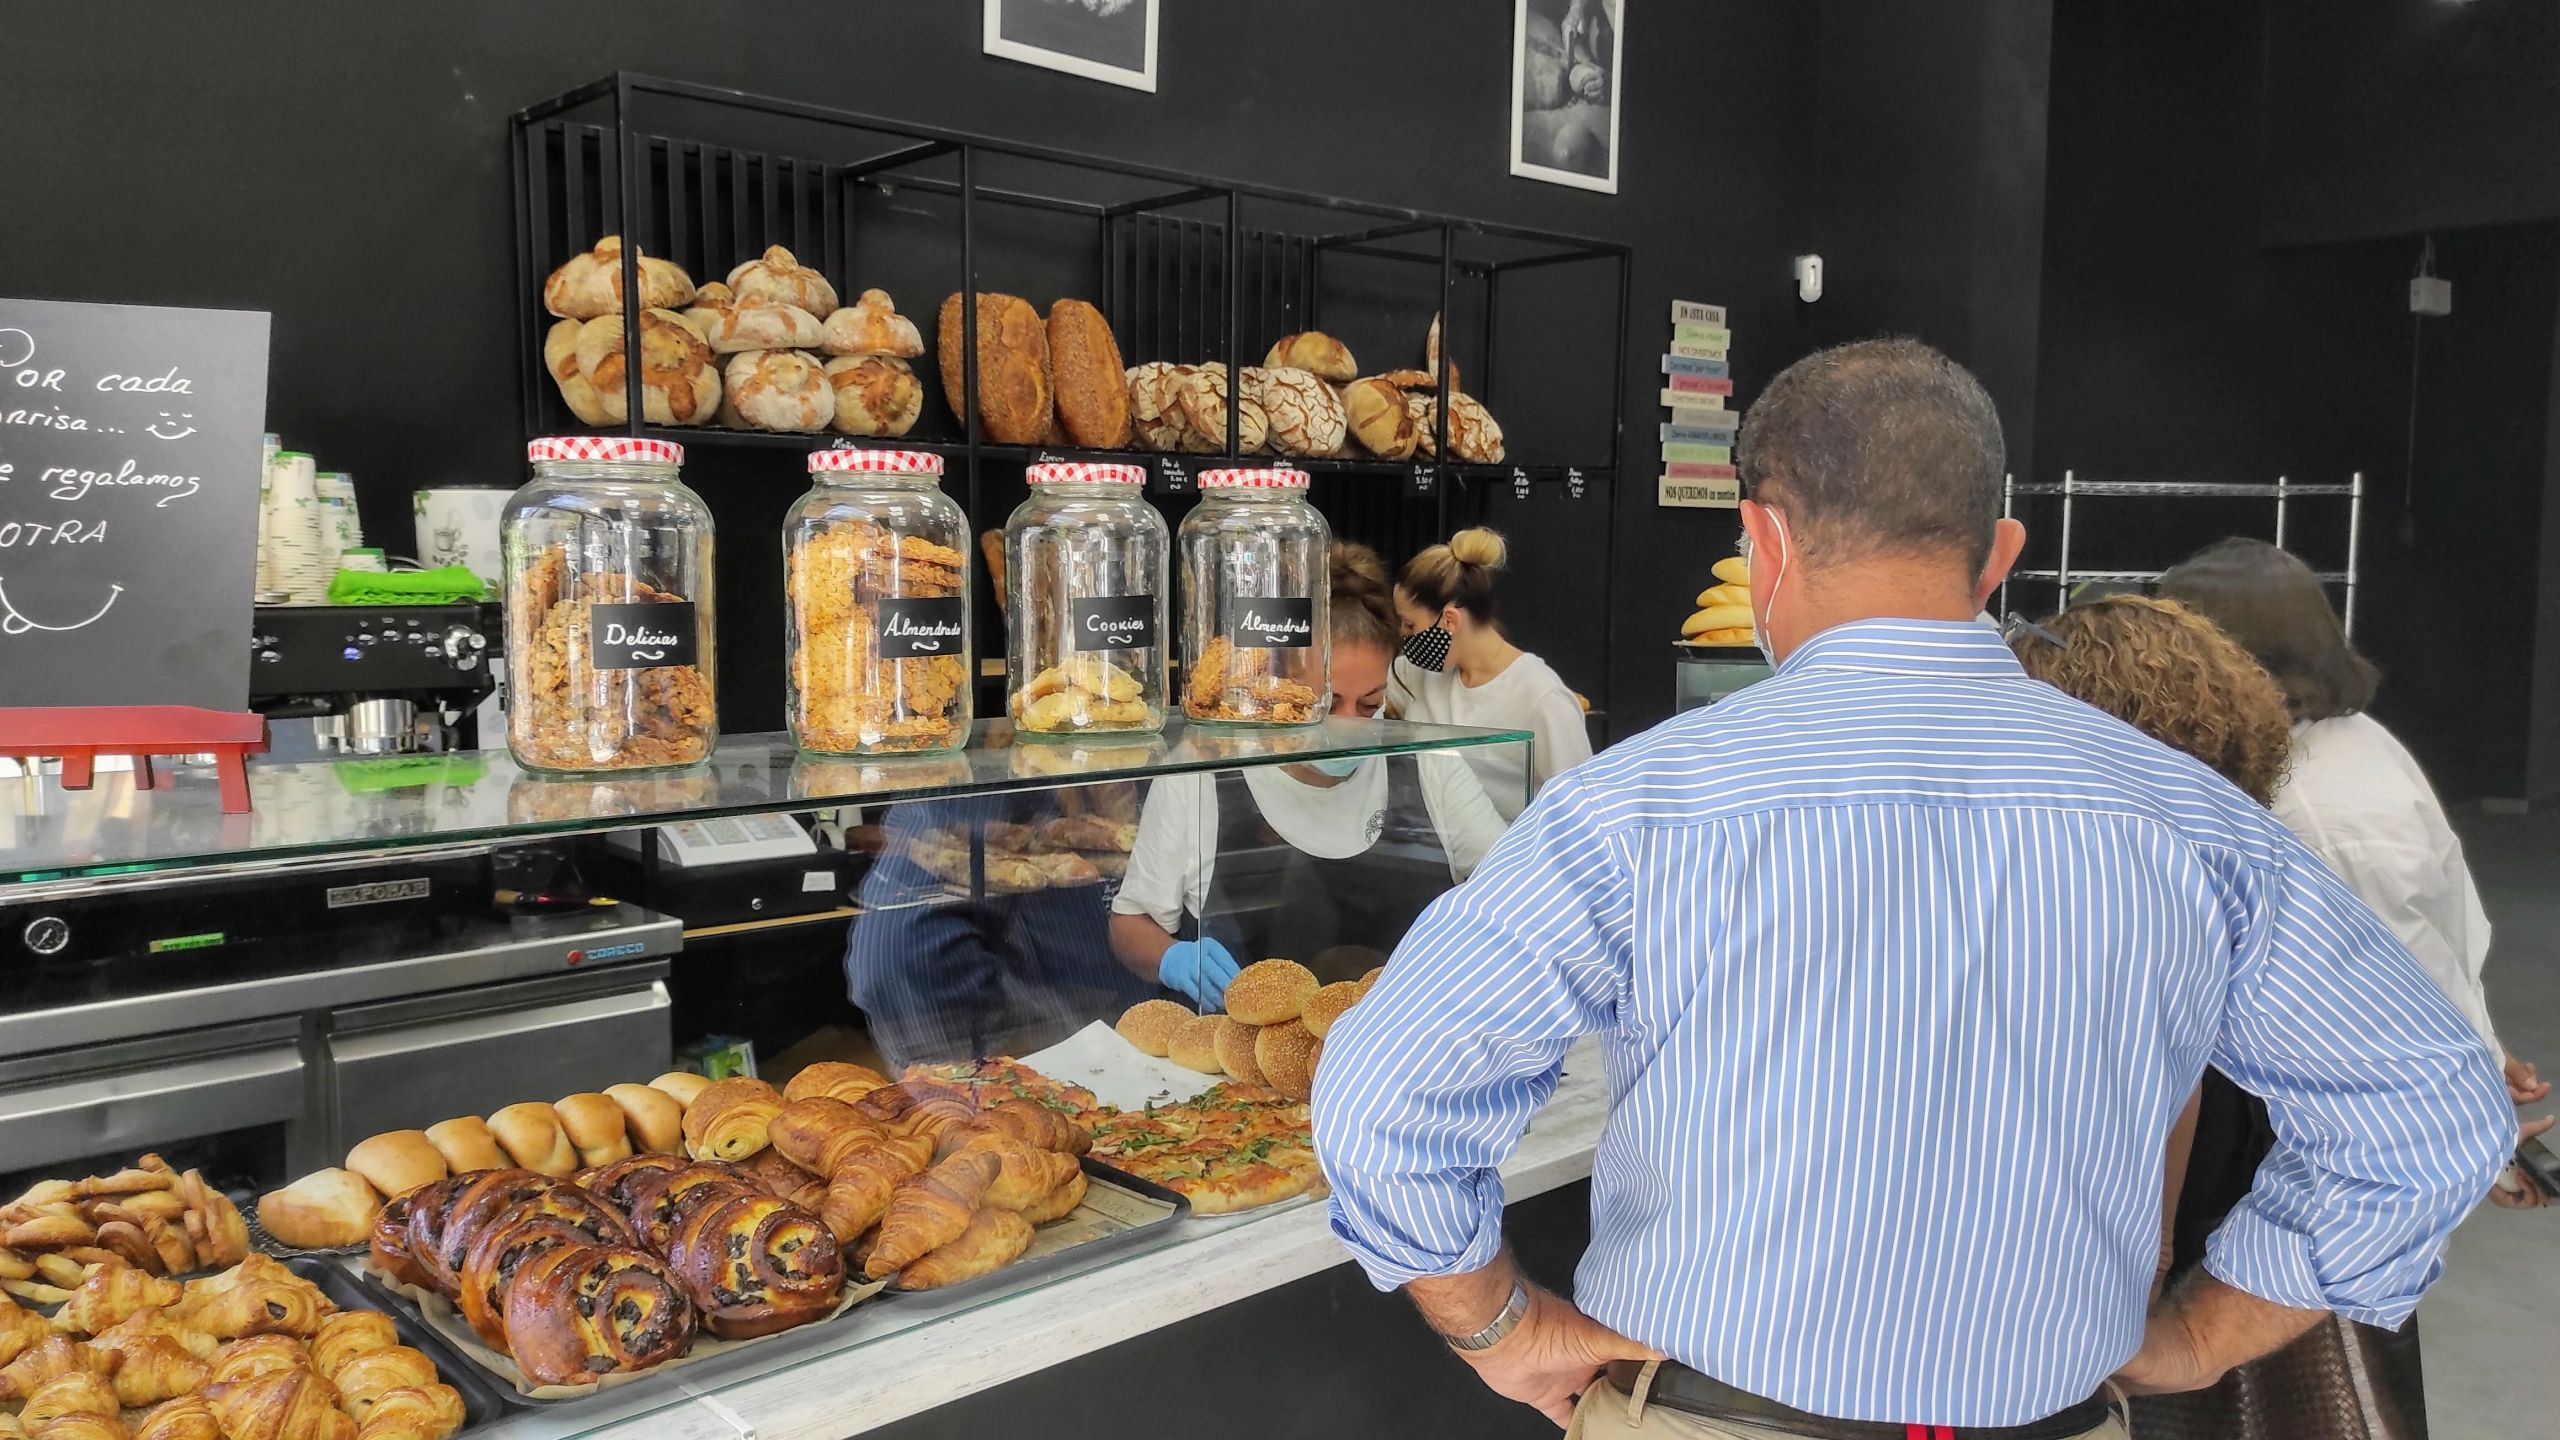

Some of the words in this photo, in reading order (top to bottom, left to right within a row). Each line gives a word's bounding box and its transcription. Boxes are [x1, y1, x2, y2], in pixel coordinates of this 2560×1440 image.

[96, 366, 193, 394] cada
[40, 459, 201, 507] regalamos
[1664, 486, 1677, 499] NOS
[1677, 487, 1708, 502] QUEREMOS
[0, 519, 108, 547] OTRA
[1240, 609, 1310, 633] Almendrado
[603, 623, 678, 646] Delicias
